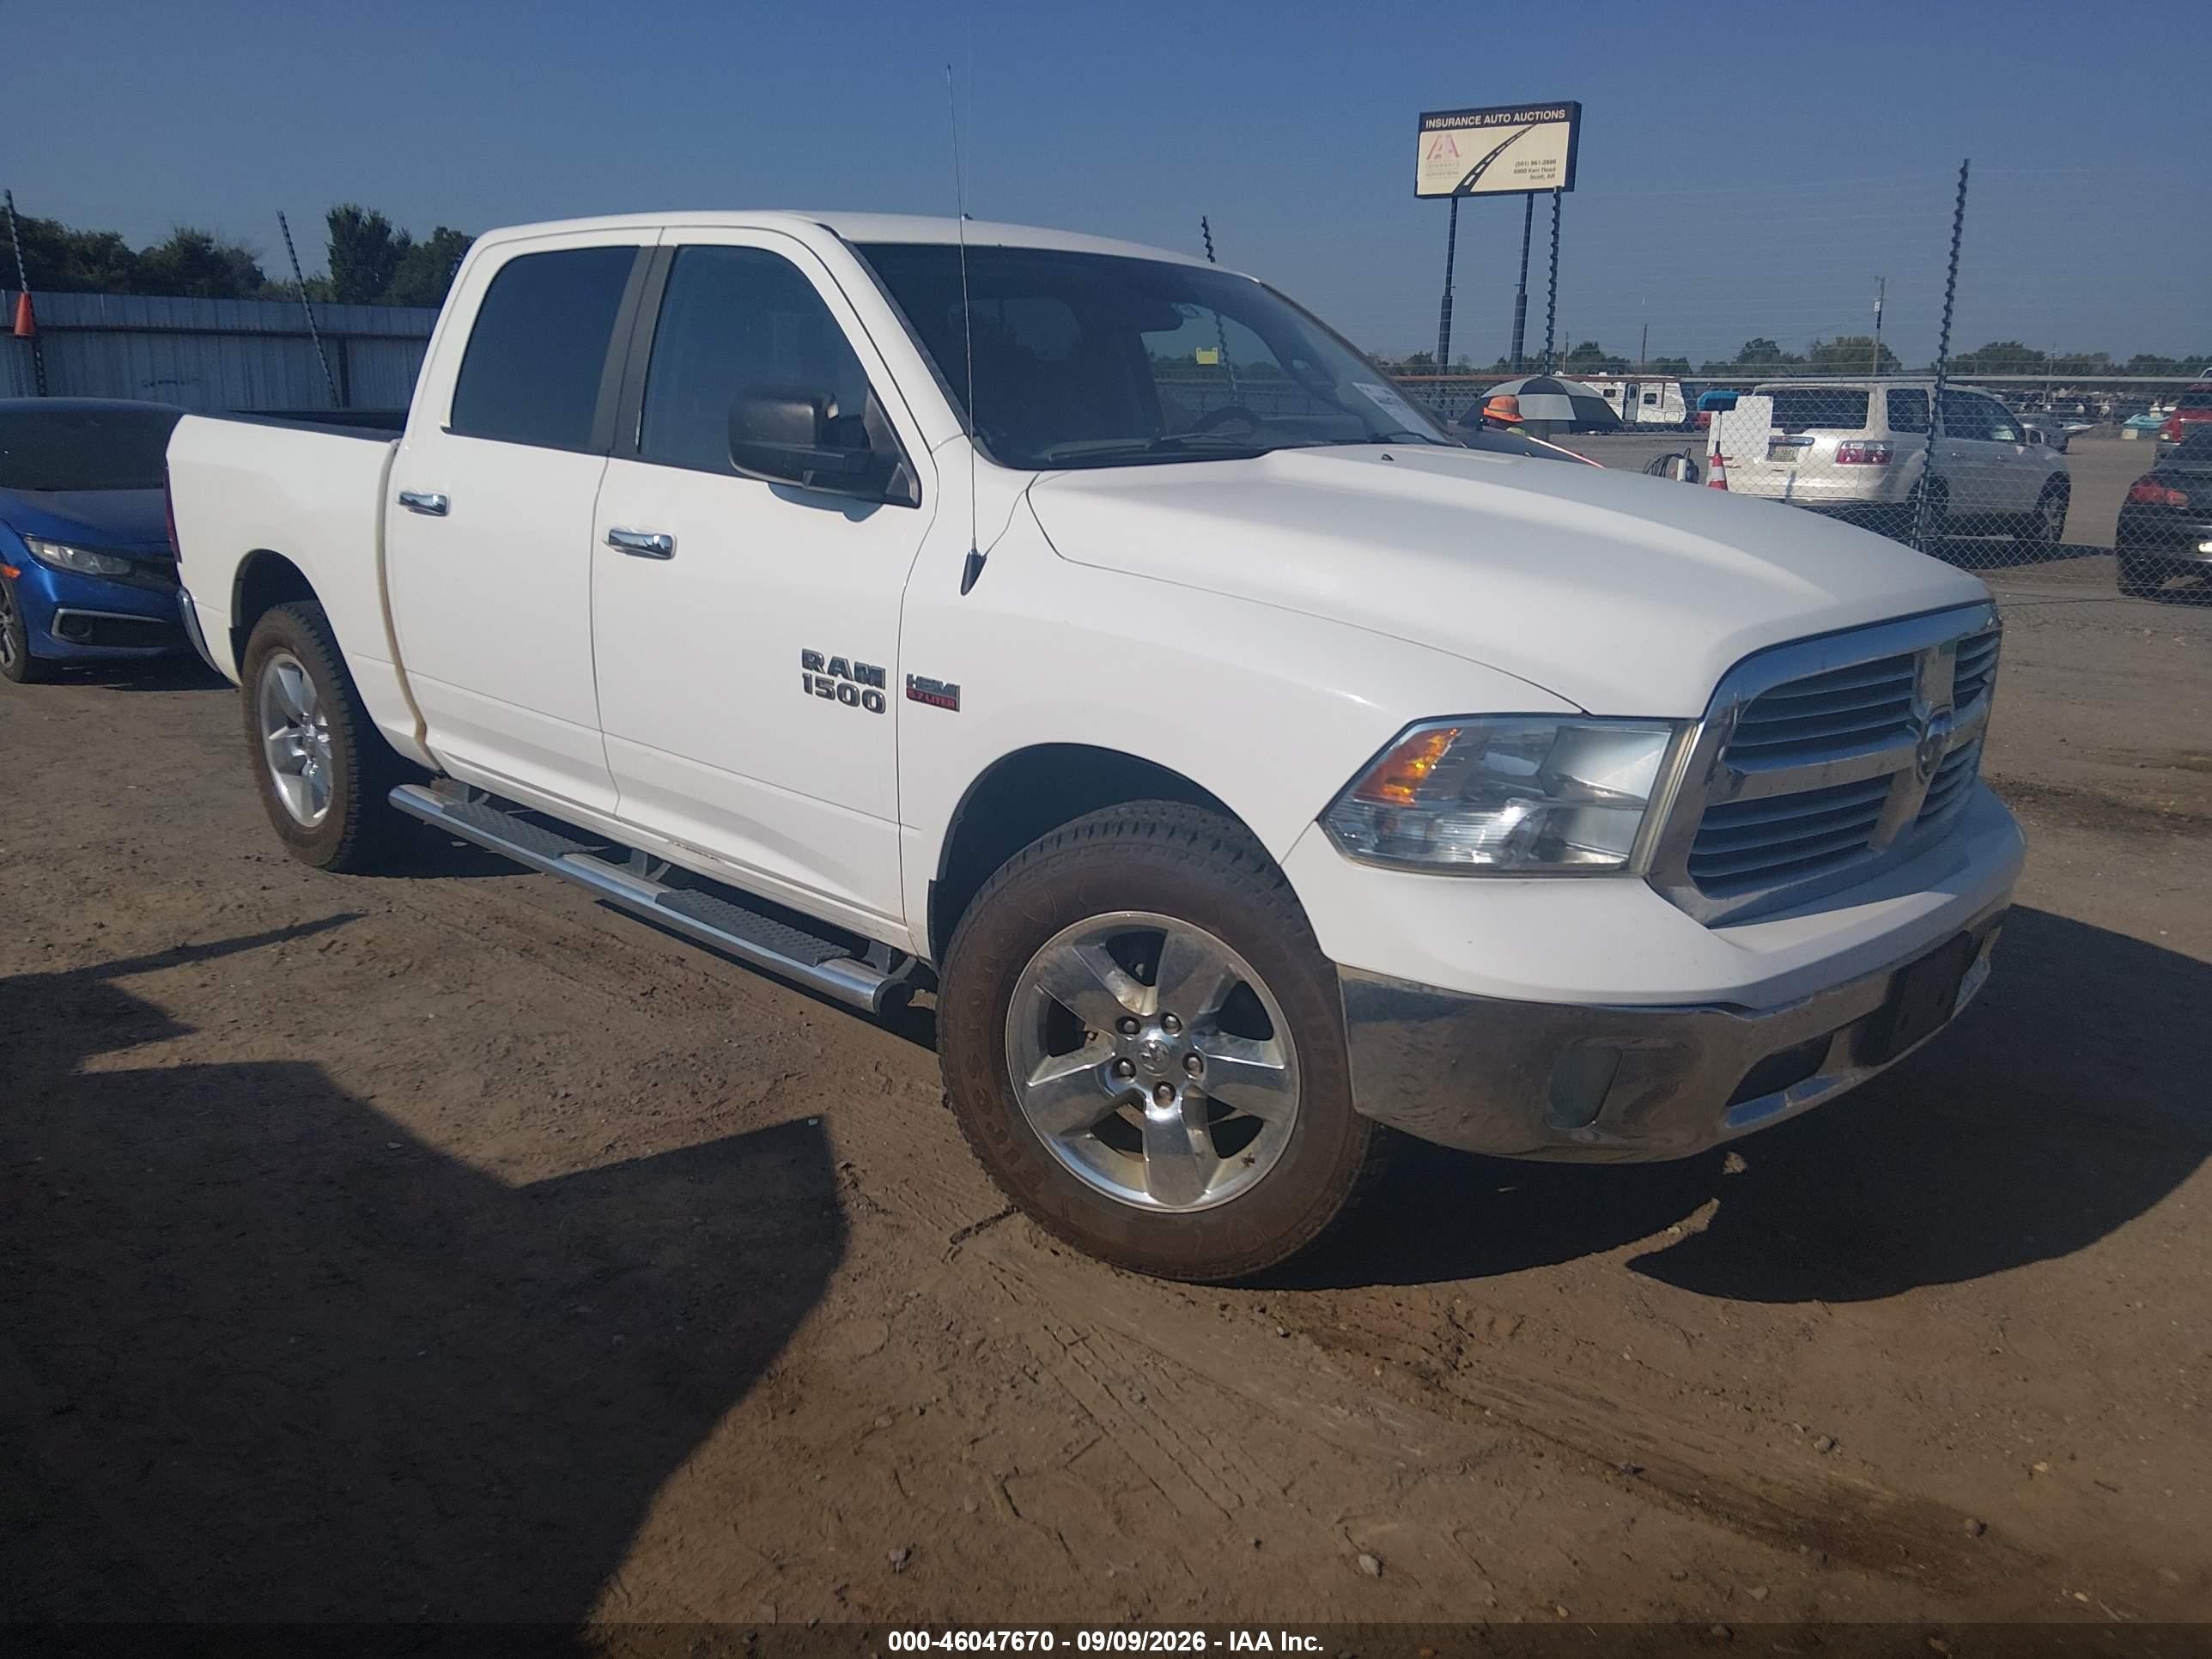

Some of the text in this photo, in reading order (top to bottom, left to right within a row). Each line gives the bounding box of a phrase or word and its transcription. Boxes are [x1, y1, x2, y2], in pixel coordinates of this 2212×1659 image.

[1425, 109, 1565, 129] INSURANCE AUTO AUCTIONS
[802, 648, 885, 690] RAM
[802, 672, 886, 714] 1500
